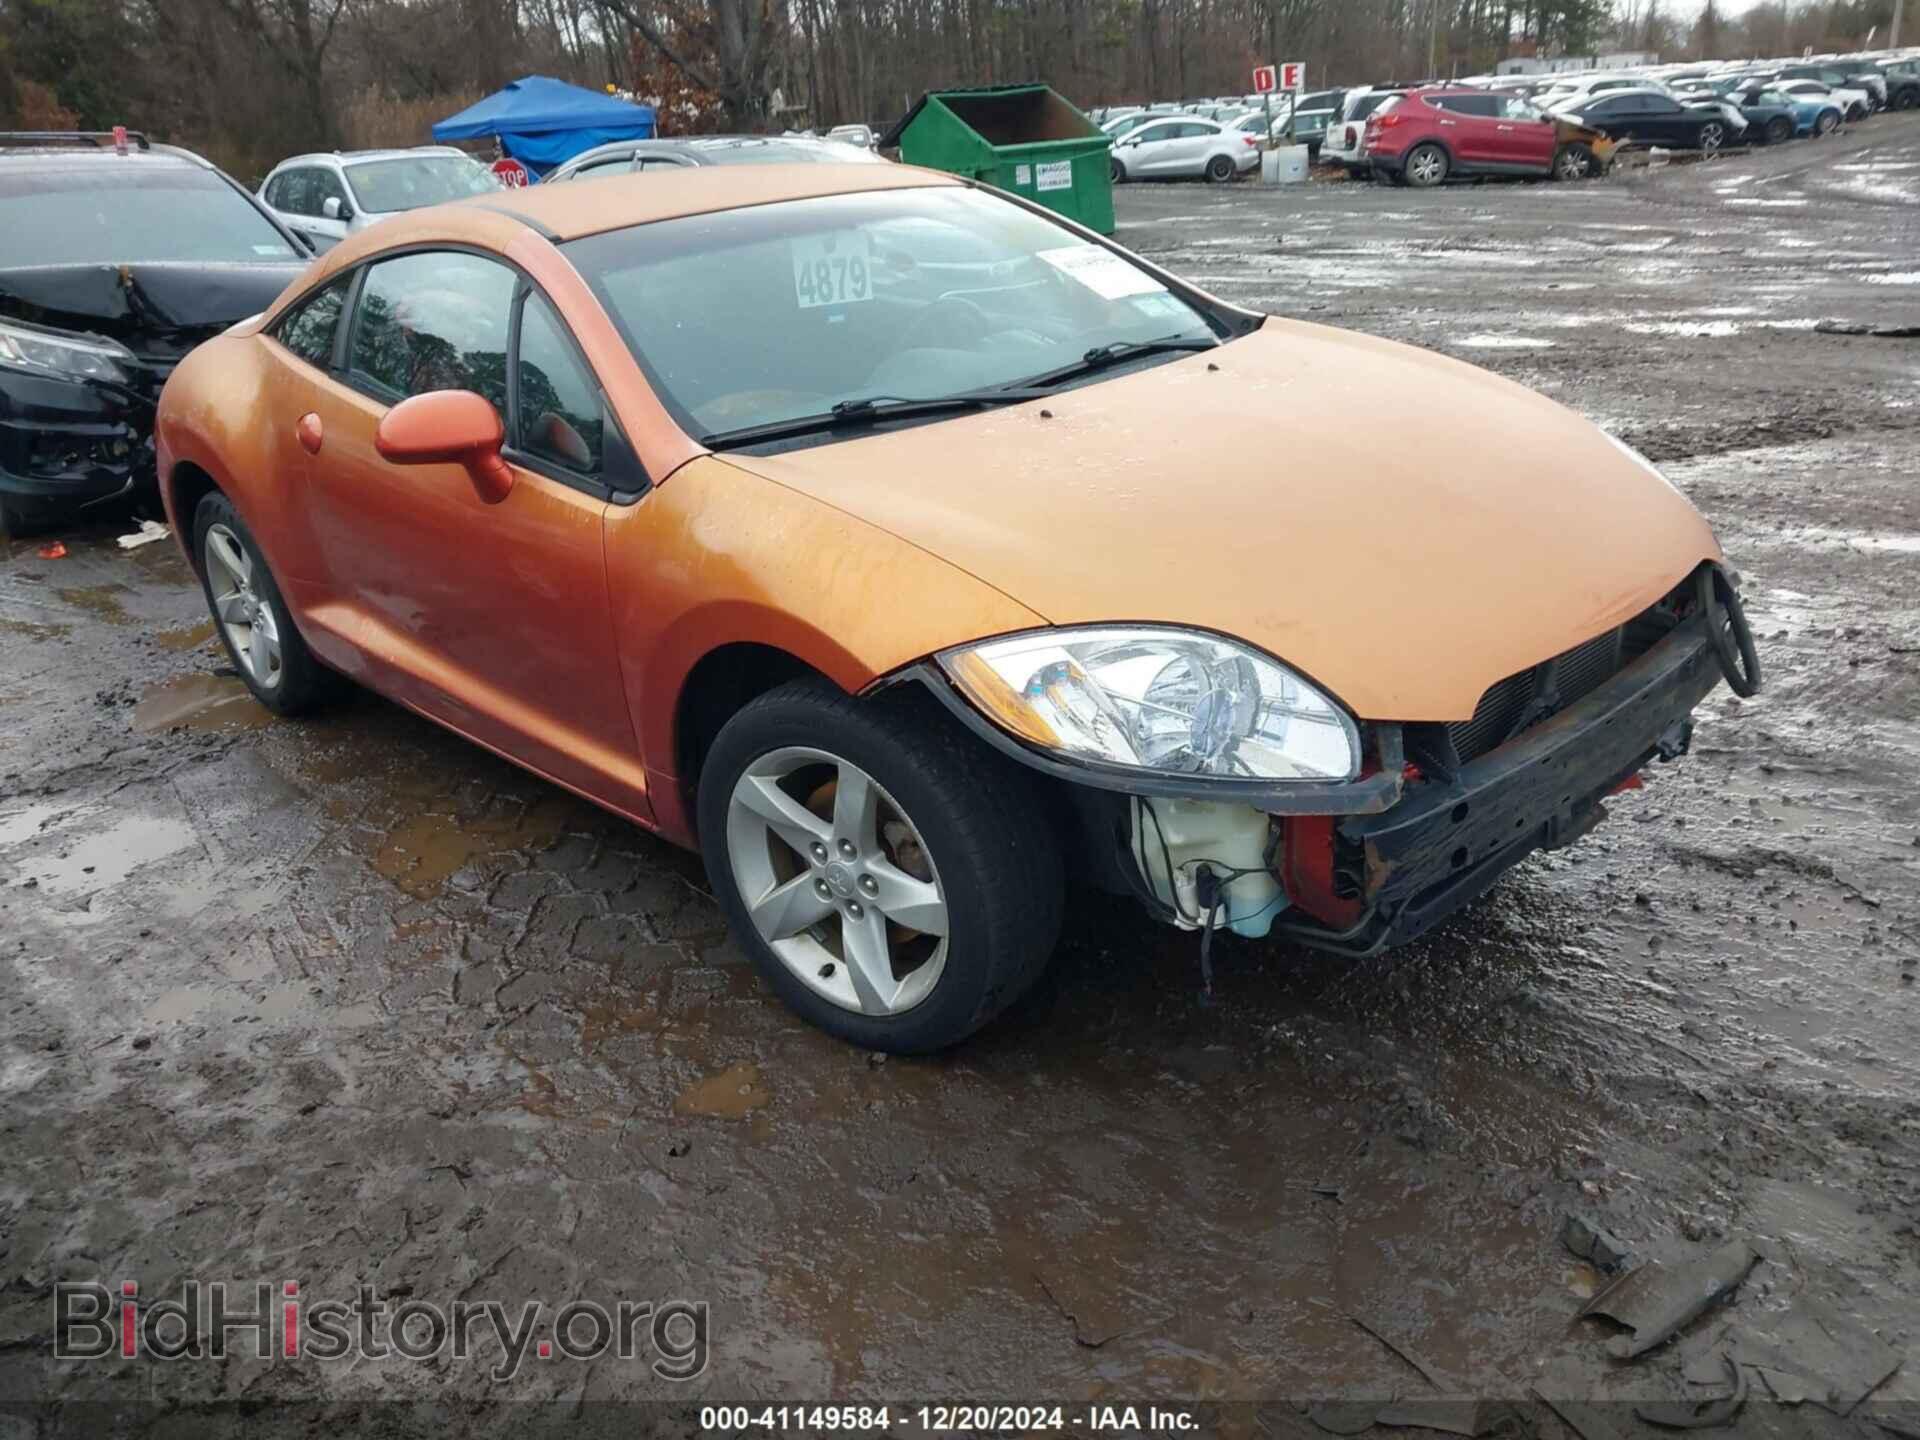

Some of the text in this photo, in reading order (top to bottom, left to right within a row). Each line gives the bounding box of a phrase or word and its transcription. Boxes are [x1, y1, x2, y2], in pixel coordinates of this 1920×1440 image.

[1284, 65, 1298, 87] E
[497, 168, 524, 187] TOP
[799, 257, 867, 304] 4879
